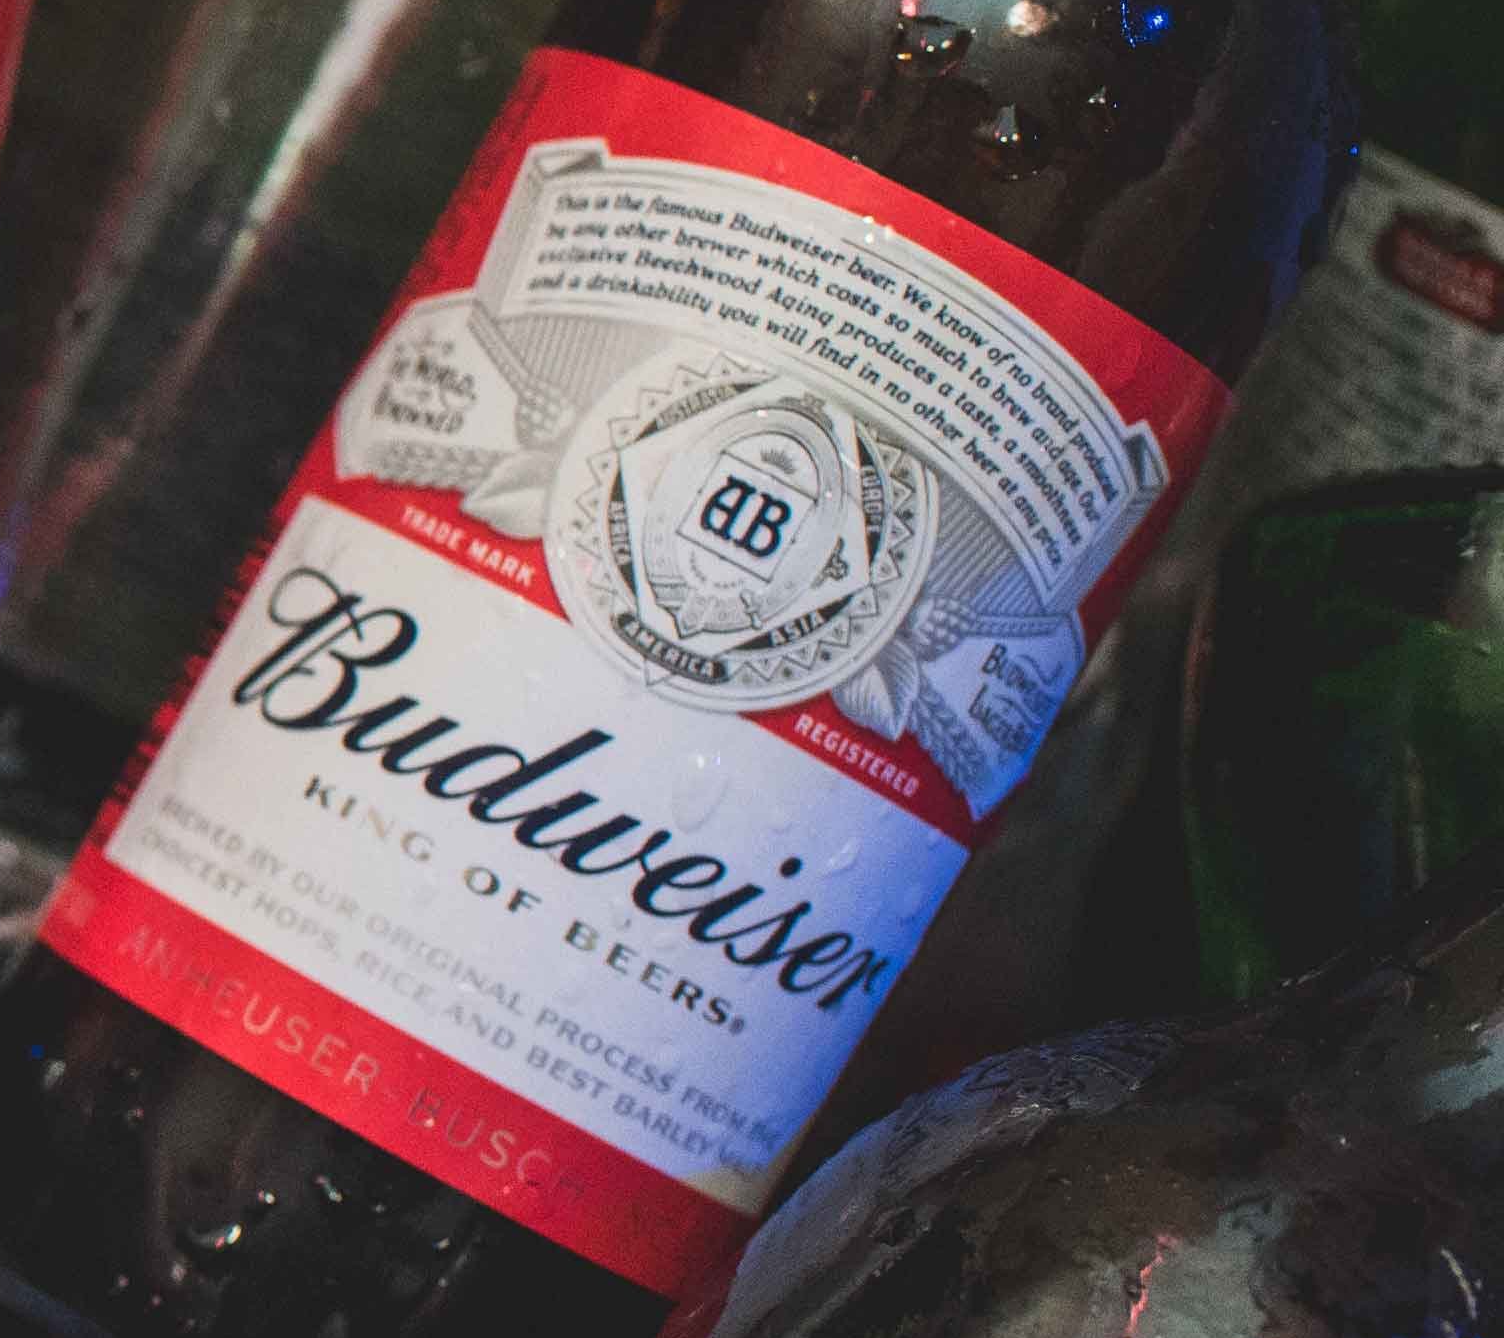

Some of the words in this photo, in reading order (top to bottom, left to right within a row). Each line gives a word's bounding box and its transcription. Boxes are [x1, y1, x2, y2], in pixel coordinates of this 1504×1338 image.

[634, 249, 765, 297] Beechwood
[838, 320, 937, 386] produces
[674, 227, 751, 261] brewer
[754, 250, 821, 289] which
[825, 281, 882, 318] costs
[884, 310, 911, 334] so
[913, 328, 970, 374] much
[729, 212, 845, 267] Budweiser
[902, 284, 934, 313] We
[933, 304, 989, 347] know
[586, 271, 715, 314] drinkability
[718, 300, 761, 329] you
[766, 314, 809, 347] will
[808, 335, 860, 372] find
[883, 379, 910, 405] no
[913, 399, 966, 443] other
[401, 503, 465, 552] TRADE
[466, 535, 537, 588] MARK
[699, 474, 793, 558] AB
[624, 617, 717, 681] AMERICA
[231, 564, 890, 1013] Budweiser
[793, 711, 922, 798] REGISTERED
[302, 772, 436, 864] KING
[462, 864, 540, 916] OF
[291, 869, 361, 921] OUR
[365, 912, 526, 1018] ORIGINAL
[535, 1006, 678, 1096] PROCESS
[354, 947, 436, 1006] RICE
[444, 1001, 517, 1052] AND
[525, 1044, 611, 1101] BEST
